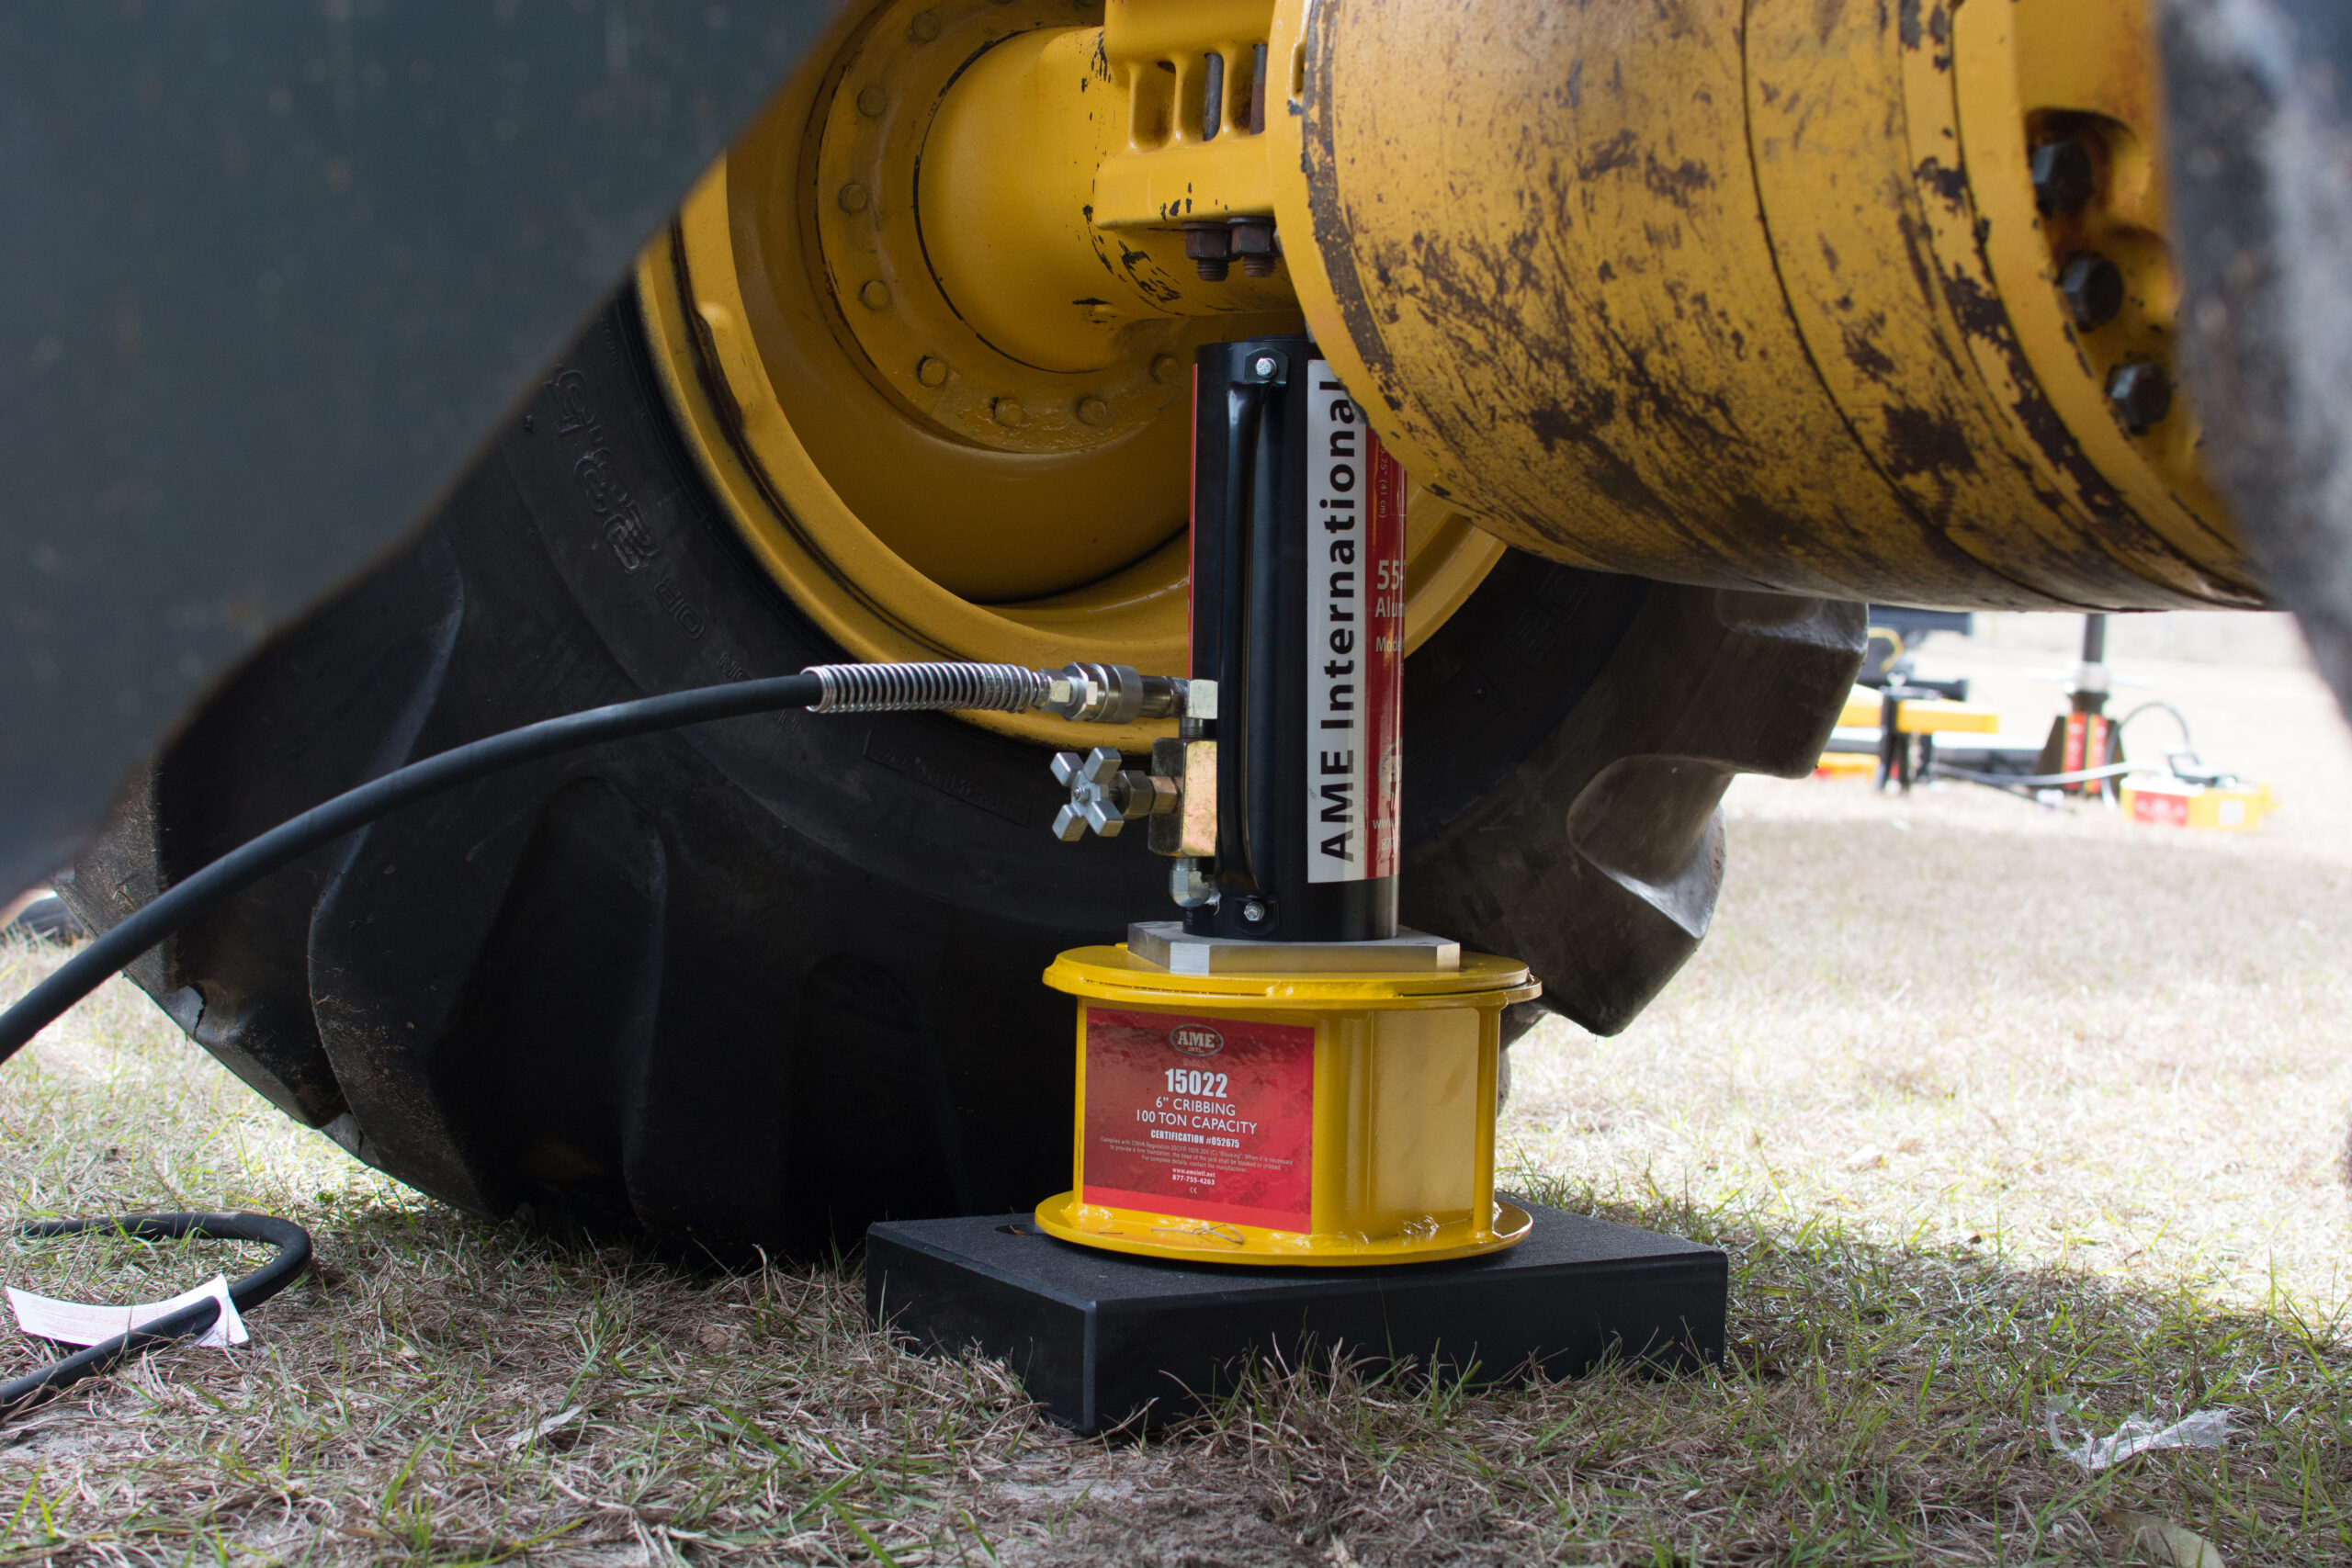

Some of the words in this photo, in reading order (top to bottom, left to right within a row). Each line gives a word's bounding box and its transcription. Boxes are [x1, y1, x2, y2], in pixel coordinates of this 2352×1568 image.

[1319, 381, 1355, 729] International
[1320, 750, 1354, 862] AME
[1177, 1031, 1216, 1048] AME
[1165, 1068, 1228, 1099] 15022
[1173, 1098, 1236, 1116] CRIBBING
[1136, 1109, 1156, 1122] 100
[1158, 1111, 1187, 1126] TON
[1192, 1116, 1257, 1134] CAPACITY
[1151, 1129, 1204, 1145] CERTIFICATION
[1172, 1174, 1215, 1185] 877-755-4263
